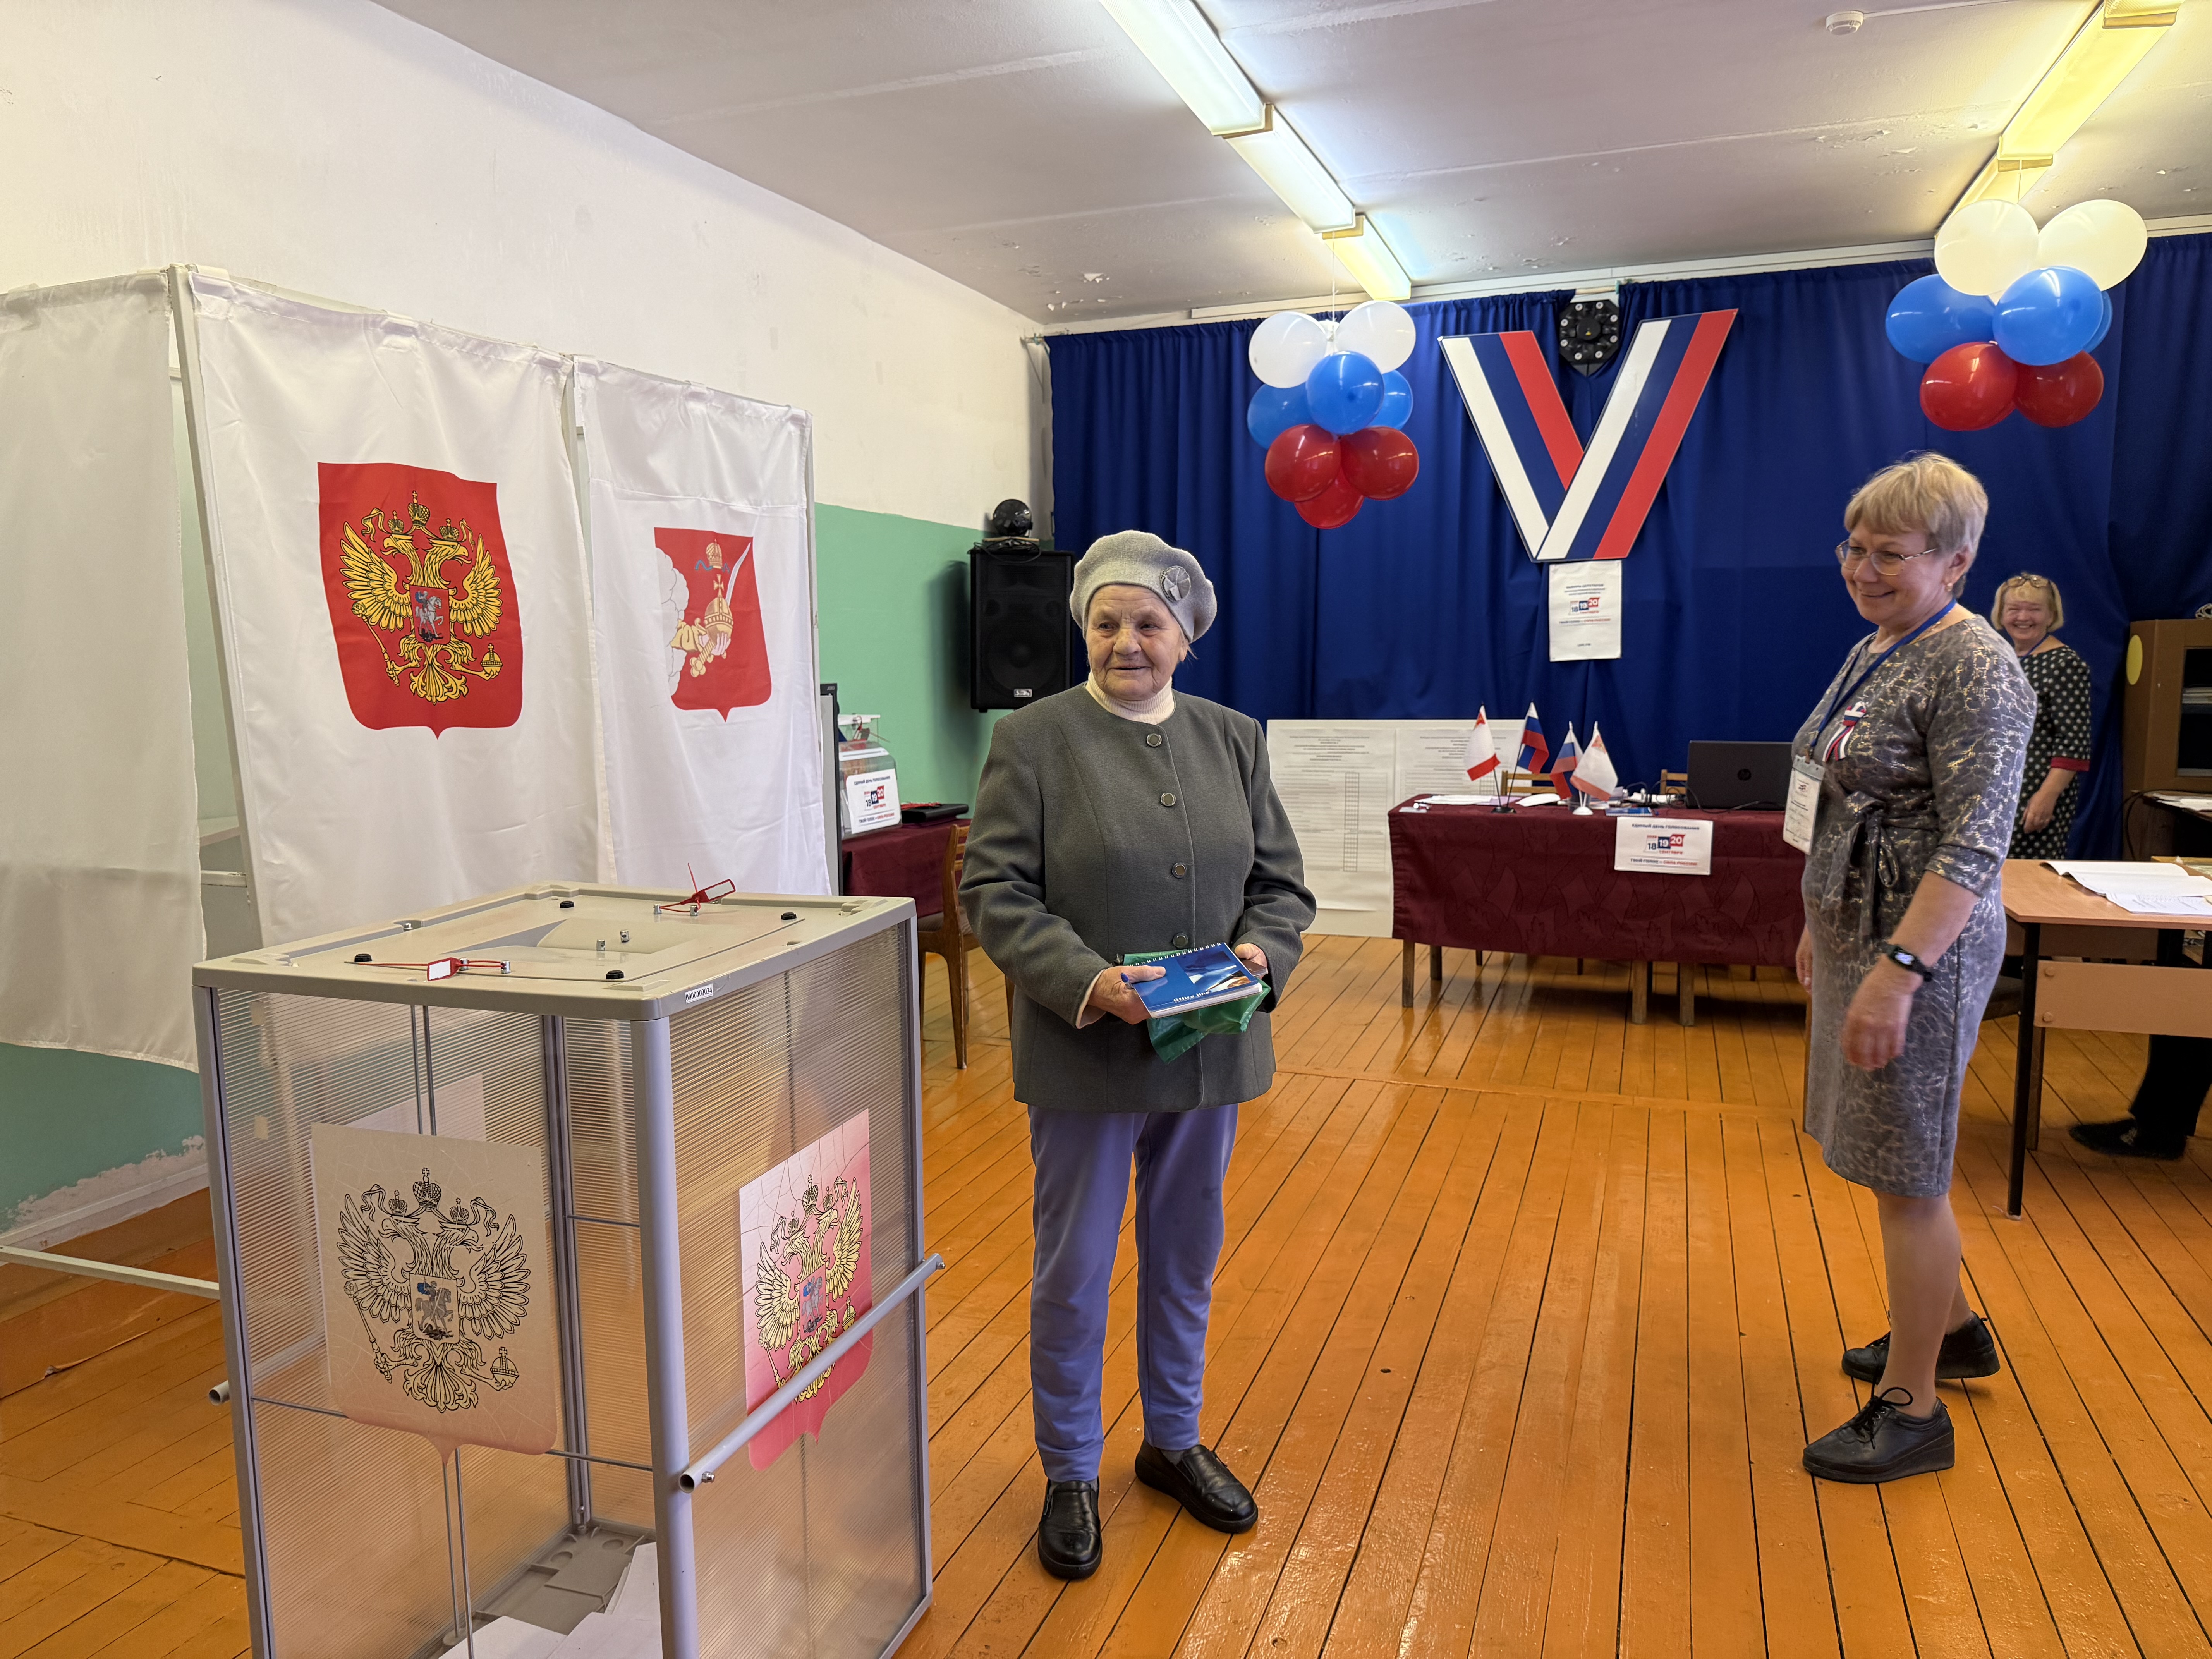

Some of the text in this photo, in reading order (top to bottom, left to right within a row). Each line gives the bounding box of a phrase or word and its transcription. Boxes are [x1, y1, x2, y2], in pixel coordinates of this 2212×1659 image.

[872, 793, 877, 802] 19
[877, 788, 884, 797] 20
[1659, 839, 1669, 847] 19
[1670, 836, 1682, 845] 20
[686, 987, 712, 1001] 0000000034
